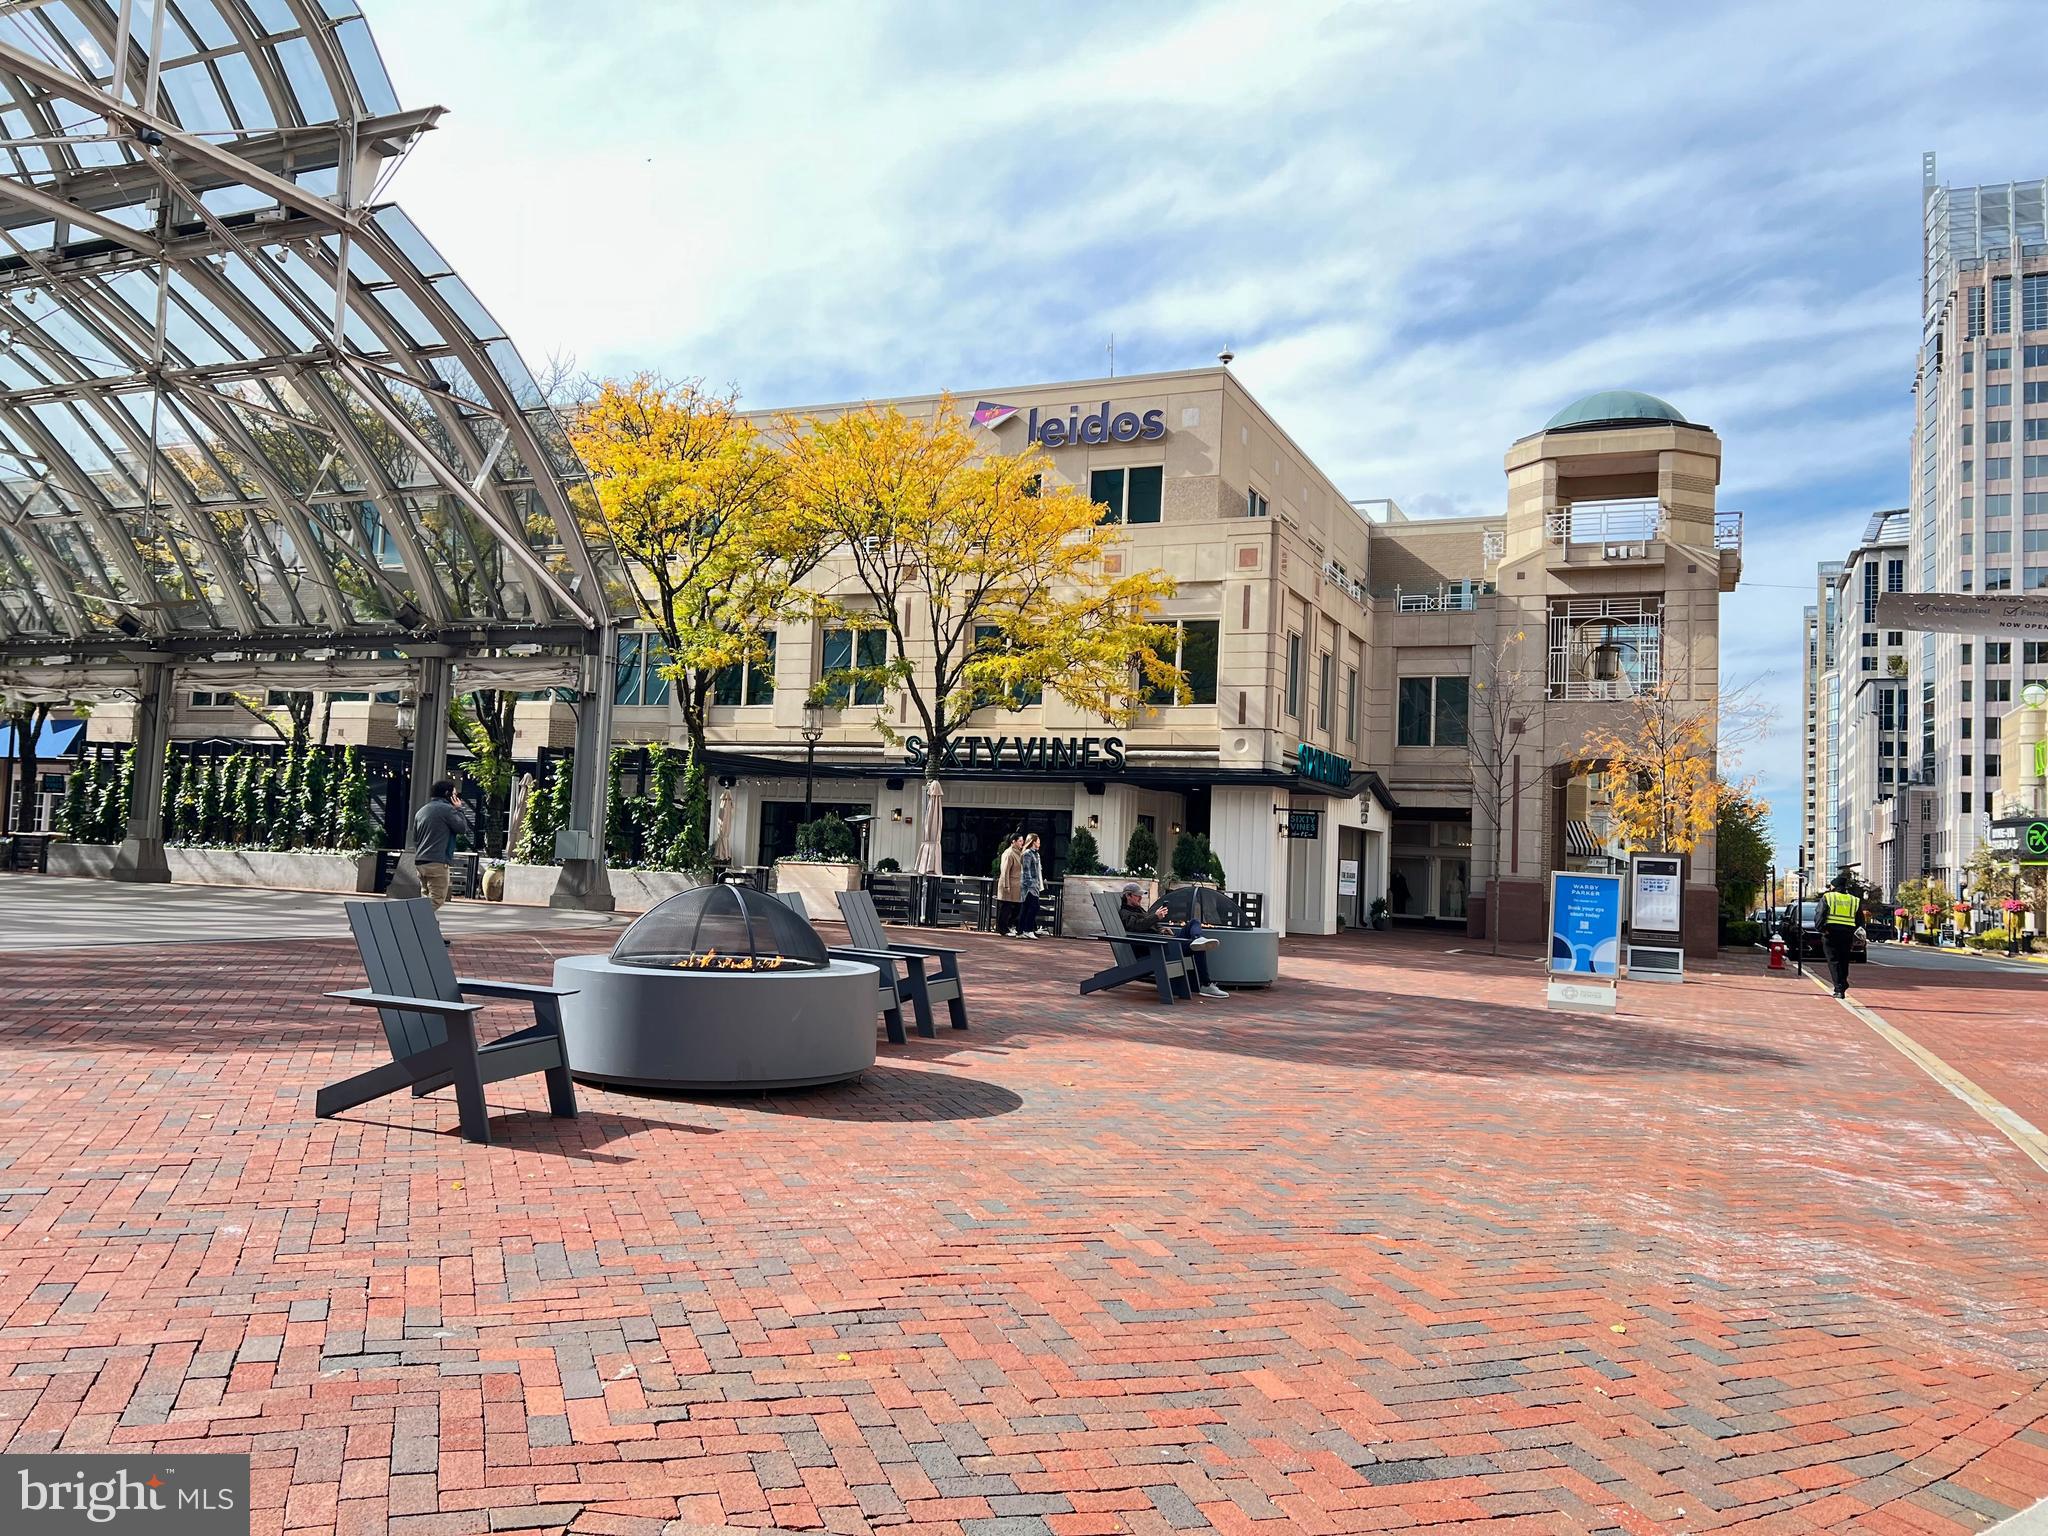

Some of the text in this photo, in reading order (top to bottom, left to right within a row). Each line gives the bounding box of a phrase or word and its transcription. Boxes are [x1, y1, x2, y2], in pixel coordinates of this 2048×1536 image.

[1027, 401, 1166, 449] leidos
[1932, 605, 1991, 615] Nearsighted
[904, 735, 1127, 770] SXTY VINES
[1290, 815, 1316, 823] SIXTY
[1290, 823, 1316, 831] VINES
[1571, 889, 1600, 897] PARKER
